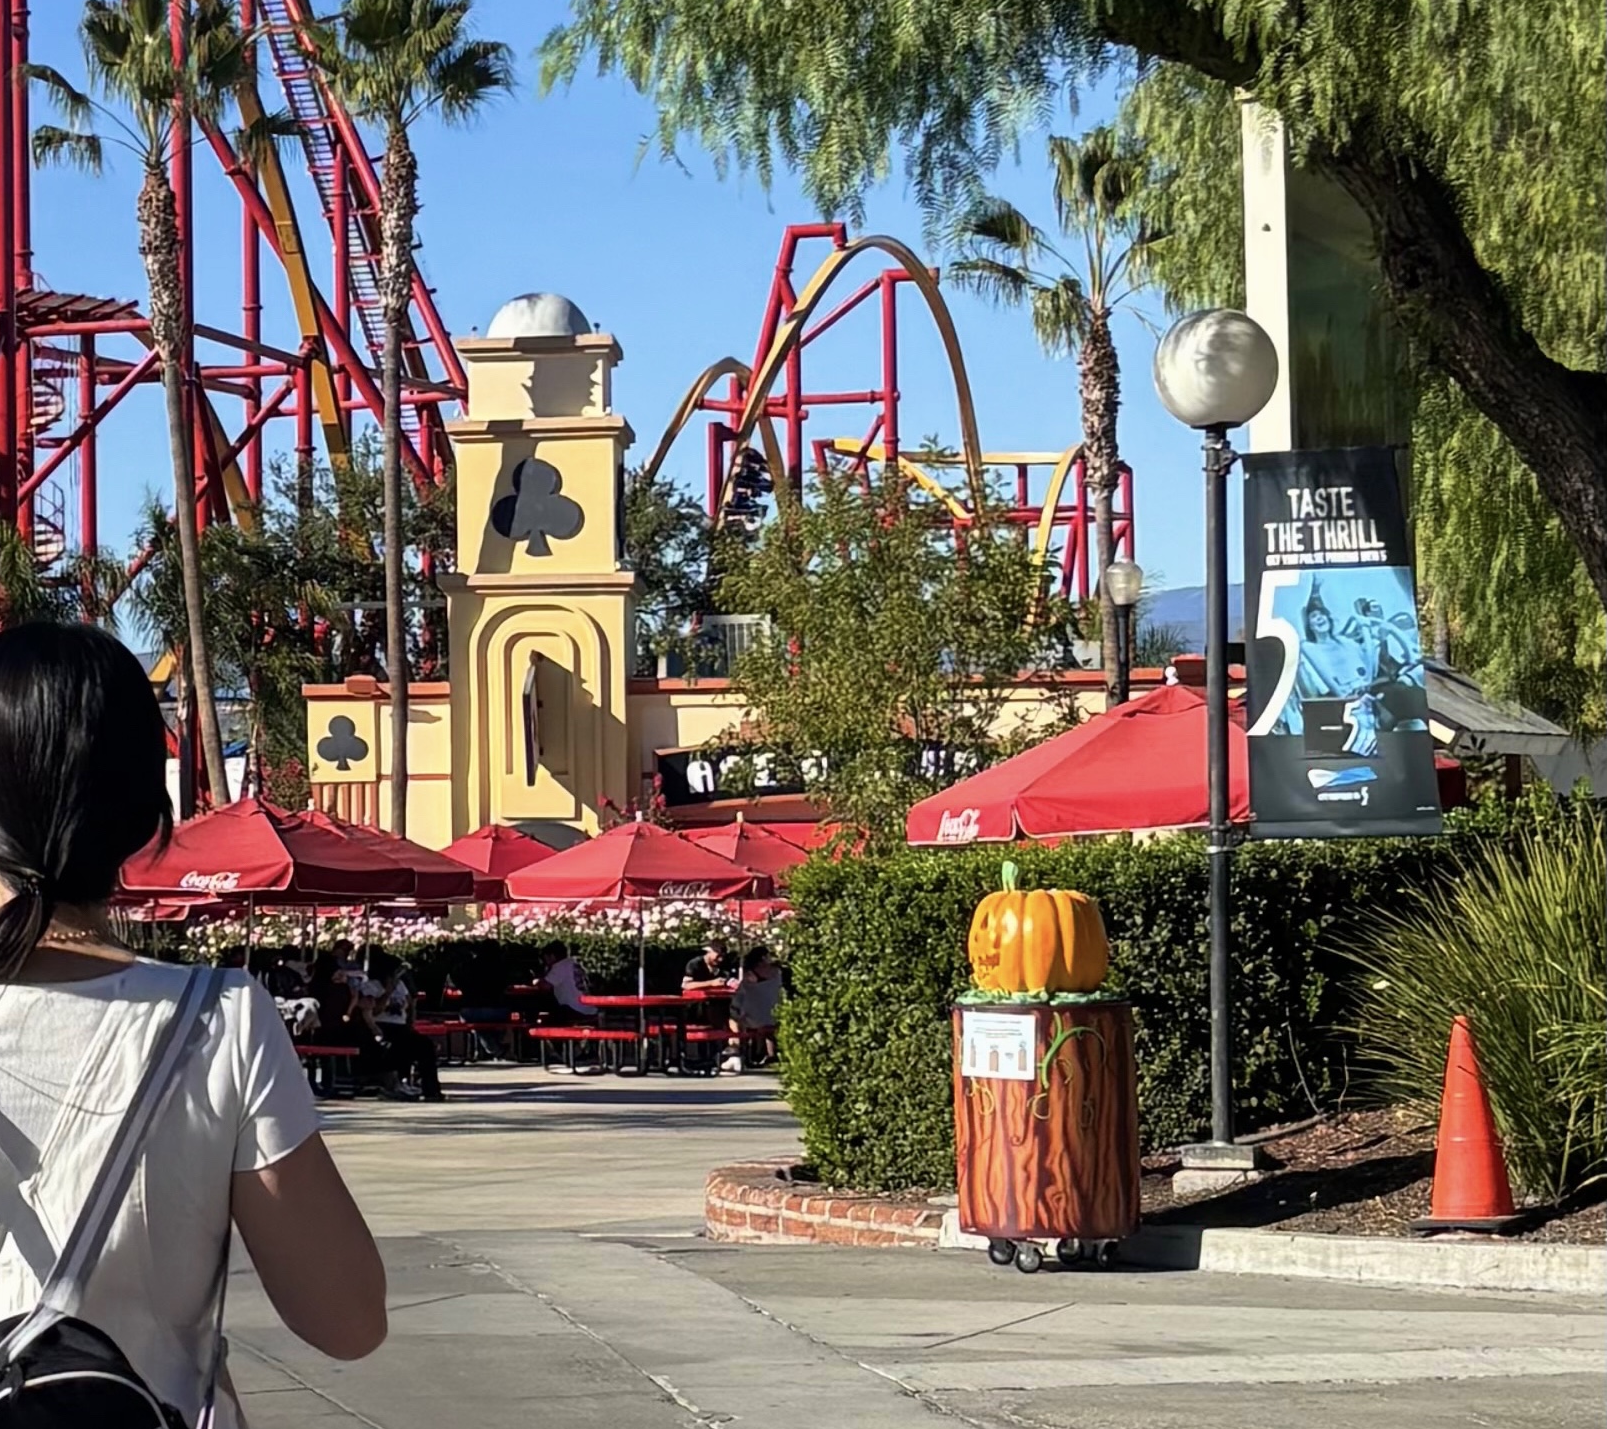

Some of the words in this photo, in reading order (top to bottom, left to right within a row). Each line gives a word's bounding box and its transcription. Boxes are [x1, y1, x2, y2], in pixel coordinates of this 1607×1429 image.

[1287, 487, 1355, 520] TASTE
[1263, 521, 1305, 553] THE
[1307, 519, 1385, 551] THRILL
[1246, 570, 1300, 736] 5
